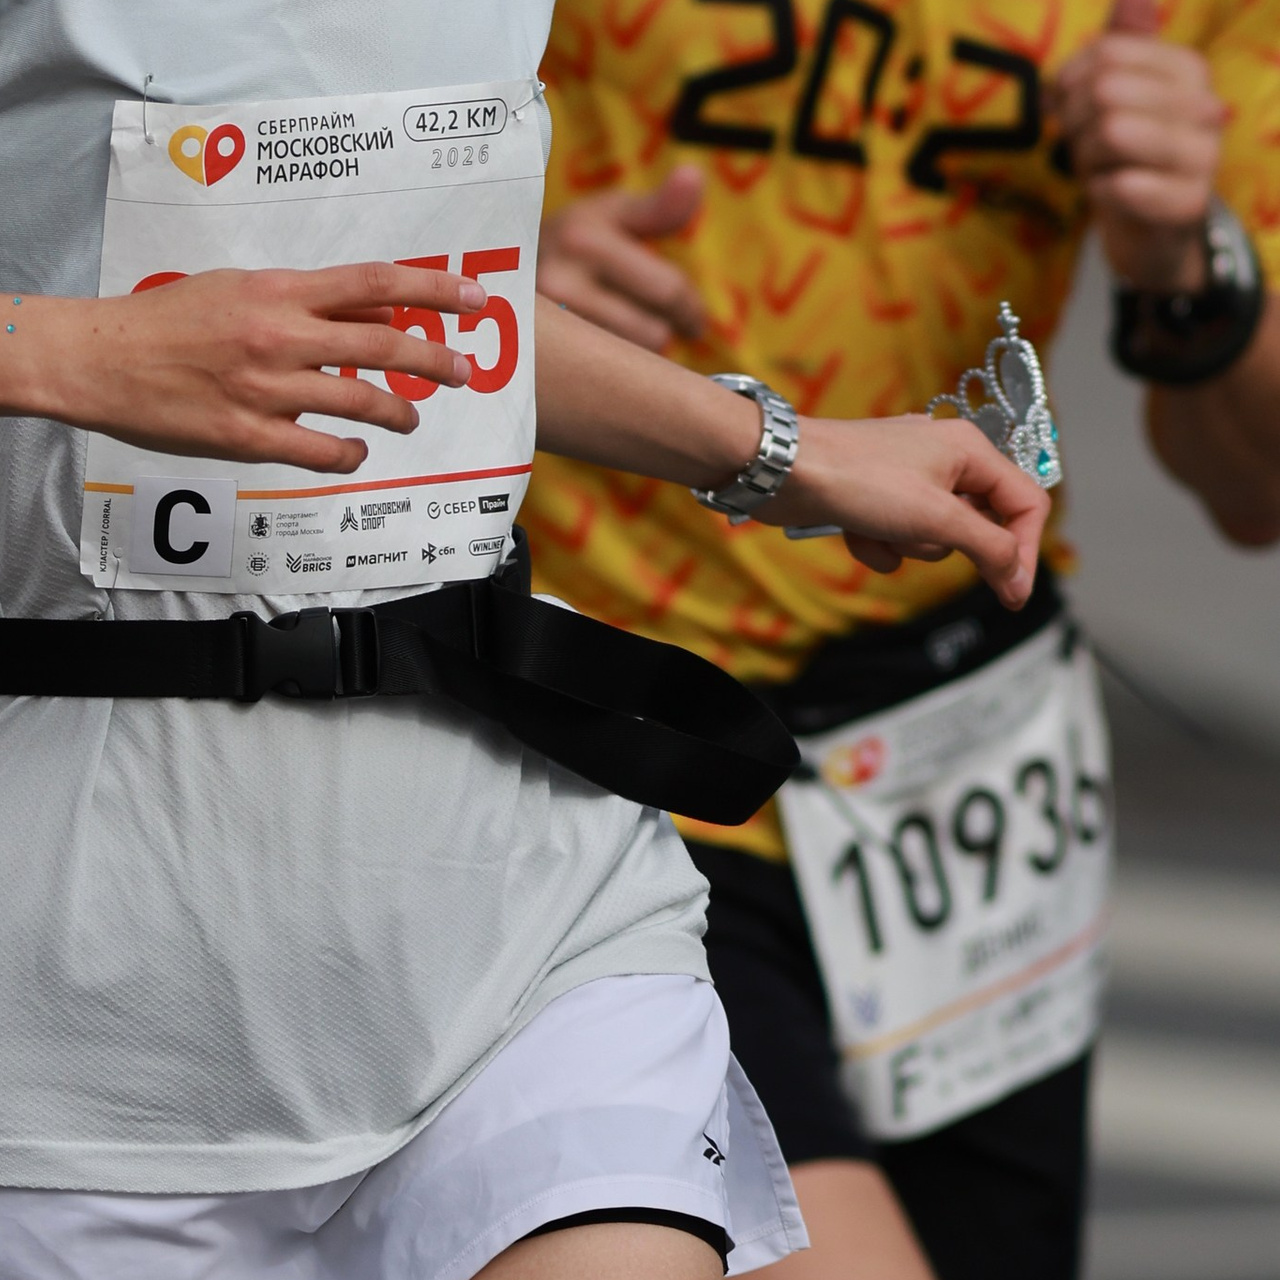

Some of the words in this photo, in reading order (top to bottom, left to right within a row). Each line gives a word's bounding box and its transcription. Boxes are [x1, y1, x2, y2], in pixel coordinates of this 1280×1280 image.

[257, 111, 356, 136] СБЕРПРАЙМ
[415, 109, 459, 134] 42,2
[467, 105, 497, 129] КМ
[257, 126, 395, 161] МОСКОВСКИЙ
[431, 144, 489, 169] 2026
[256, 157, 360, 185] МАРАФОН
[102, 498, 112, 530] CORRAL
[276, 511, 319, 521] Департамент
[360, 497, 412, 517] МОСКОВСКИЙ
[444, 500, 477, 515] СБЕР
[153, 489, 212, 565] C
[275, 529, 299, 538] города
[300, 528, 325, 536] Москвы
[276, 521, 299, 529] спорта
[361, 516, 386, 531] СПОРТ
[99, 535, 109, 573] КЛАСТЕР
[438, 546, 456, 556] сбп
[472, 540, 501, 553] WINLINE
[302, 561, 332, 573] BRICS
